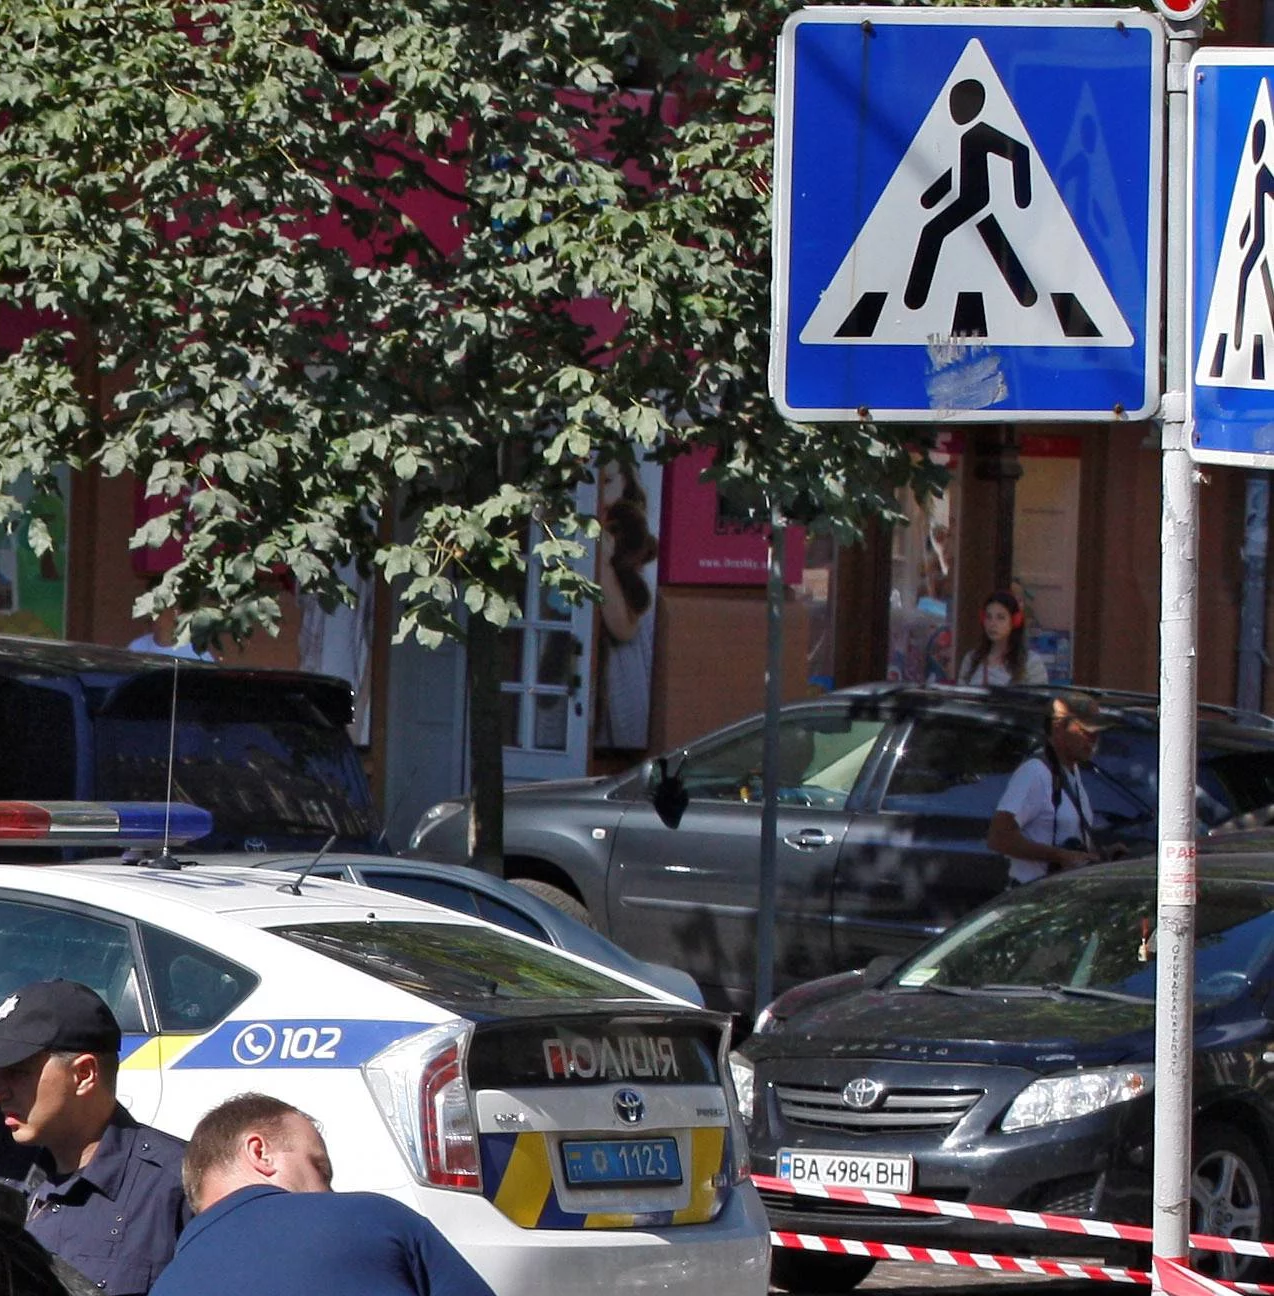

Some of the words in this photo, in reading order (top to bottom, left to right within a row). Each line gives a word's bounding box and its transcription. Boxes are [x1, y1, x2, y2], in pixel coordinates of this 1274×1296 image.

[279, 1026, 342, 1060] 102
[542, 1035, 679, 1080] ПОЛІЦІЯ
[618, 1143, 668, 1177] 1123
[826, 1159, 871, 1184] 4984
